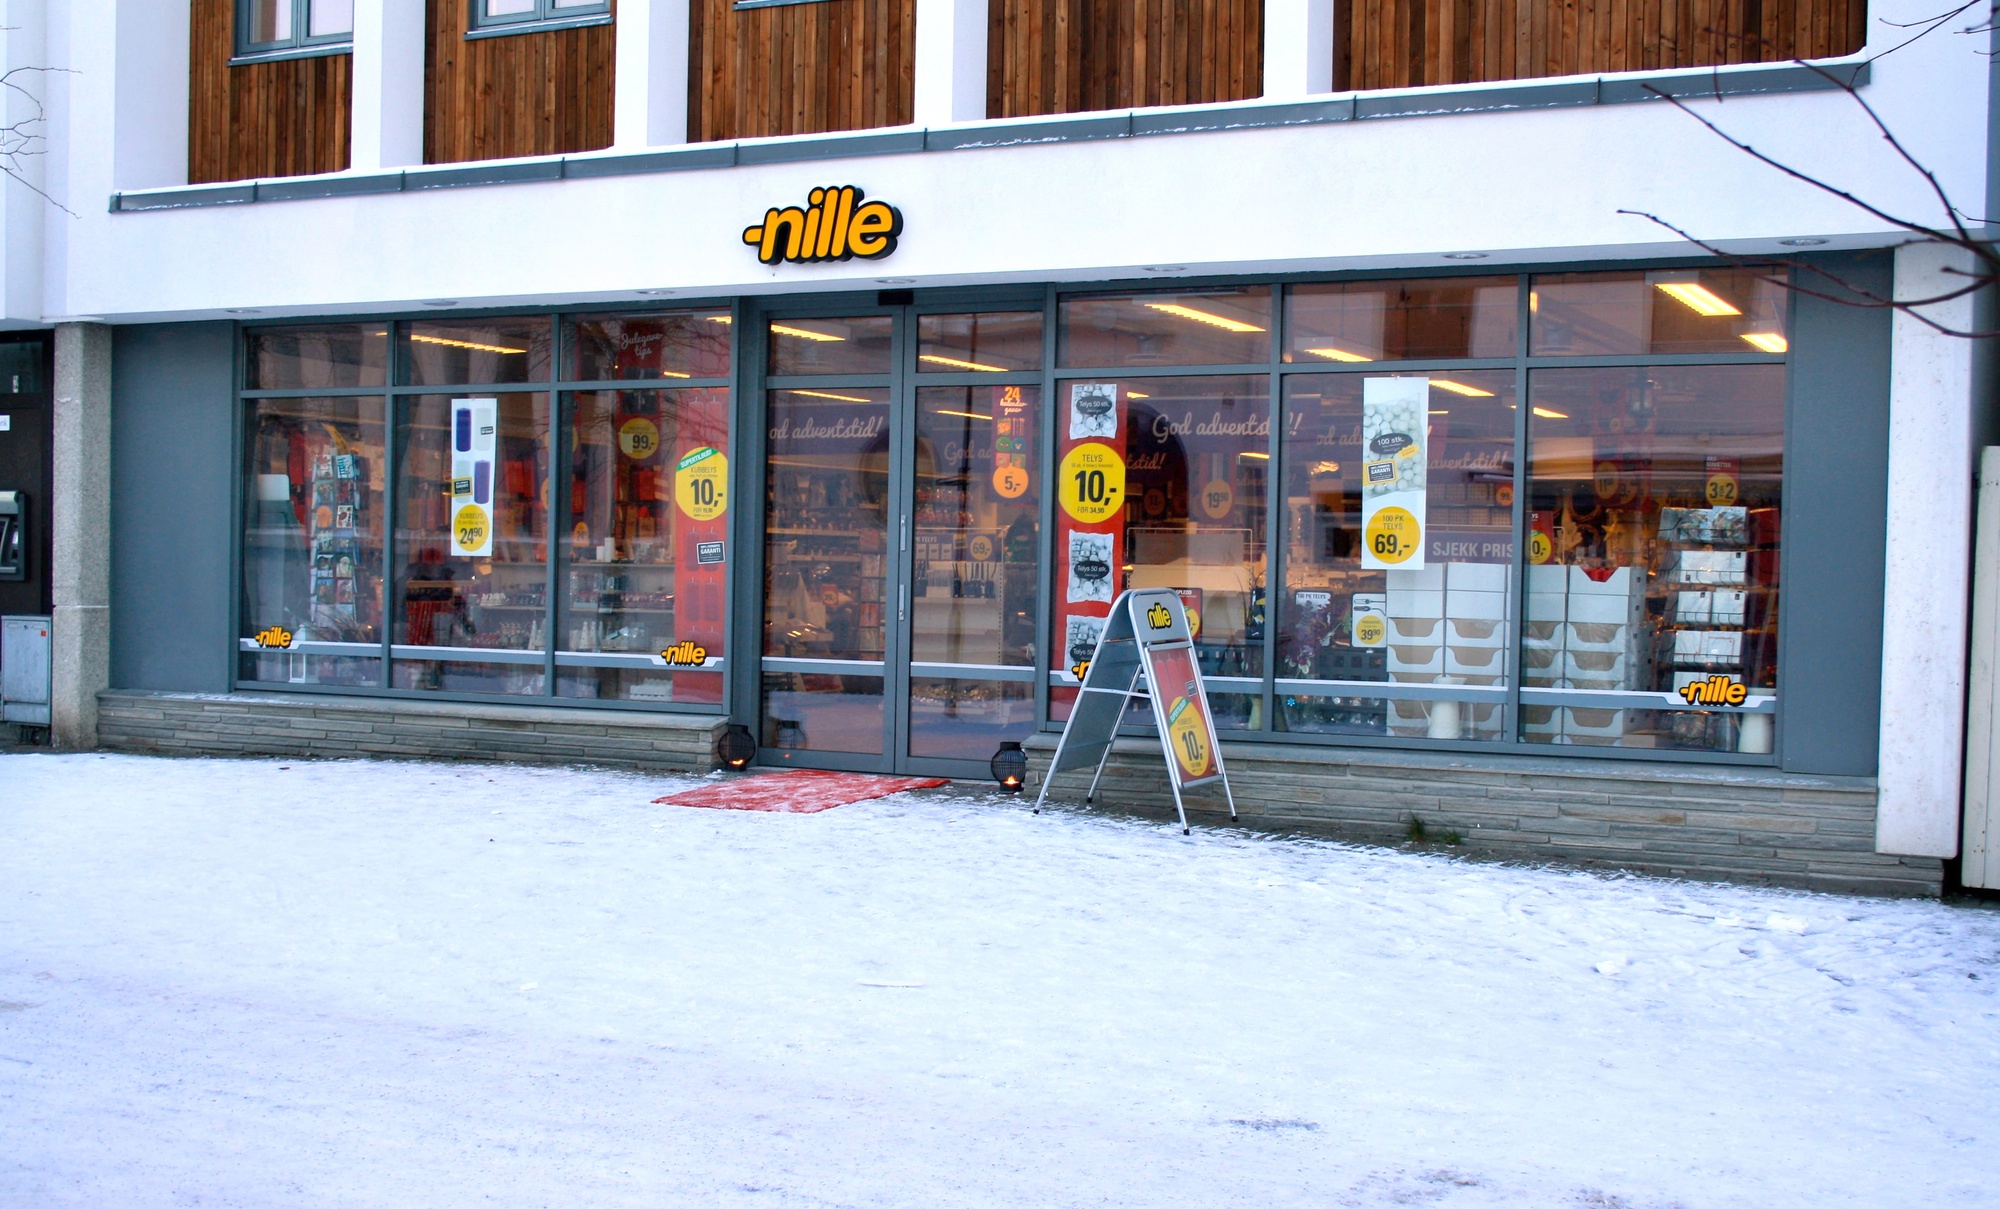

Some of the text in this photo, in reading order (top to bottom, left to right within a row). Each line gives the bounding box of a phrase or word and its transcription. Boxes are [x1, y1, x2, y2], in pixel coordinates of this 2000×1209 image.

[1004, 387, 1020, 400] 24
[769, 416, 884, 440] od adventstid!
[1152, 412, 1193, 444] God
[1082, 454, 1103, 463] TELYS
[690, 478, 724, 507] 10,-
[1005, 476, 1021, 492] 5,-
[1074, 470, 1117, 506] 10,-
[1709, 482, 1718, 499] 3
[1725, 482, 1735, 500] 2
[1374, 534, 1411, 557] 69,-
[1433, 541, 1478, 557] SJEKK
[1148, 603, 1172, 630] nille
